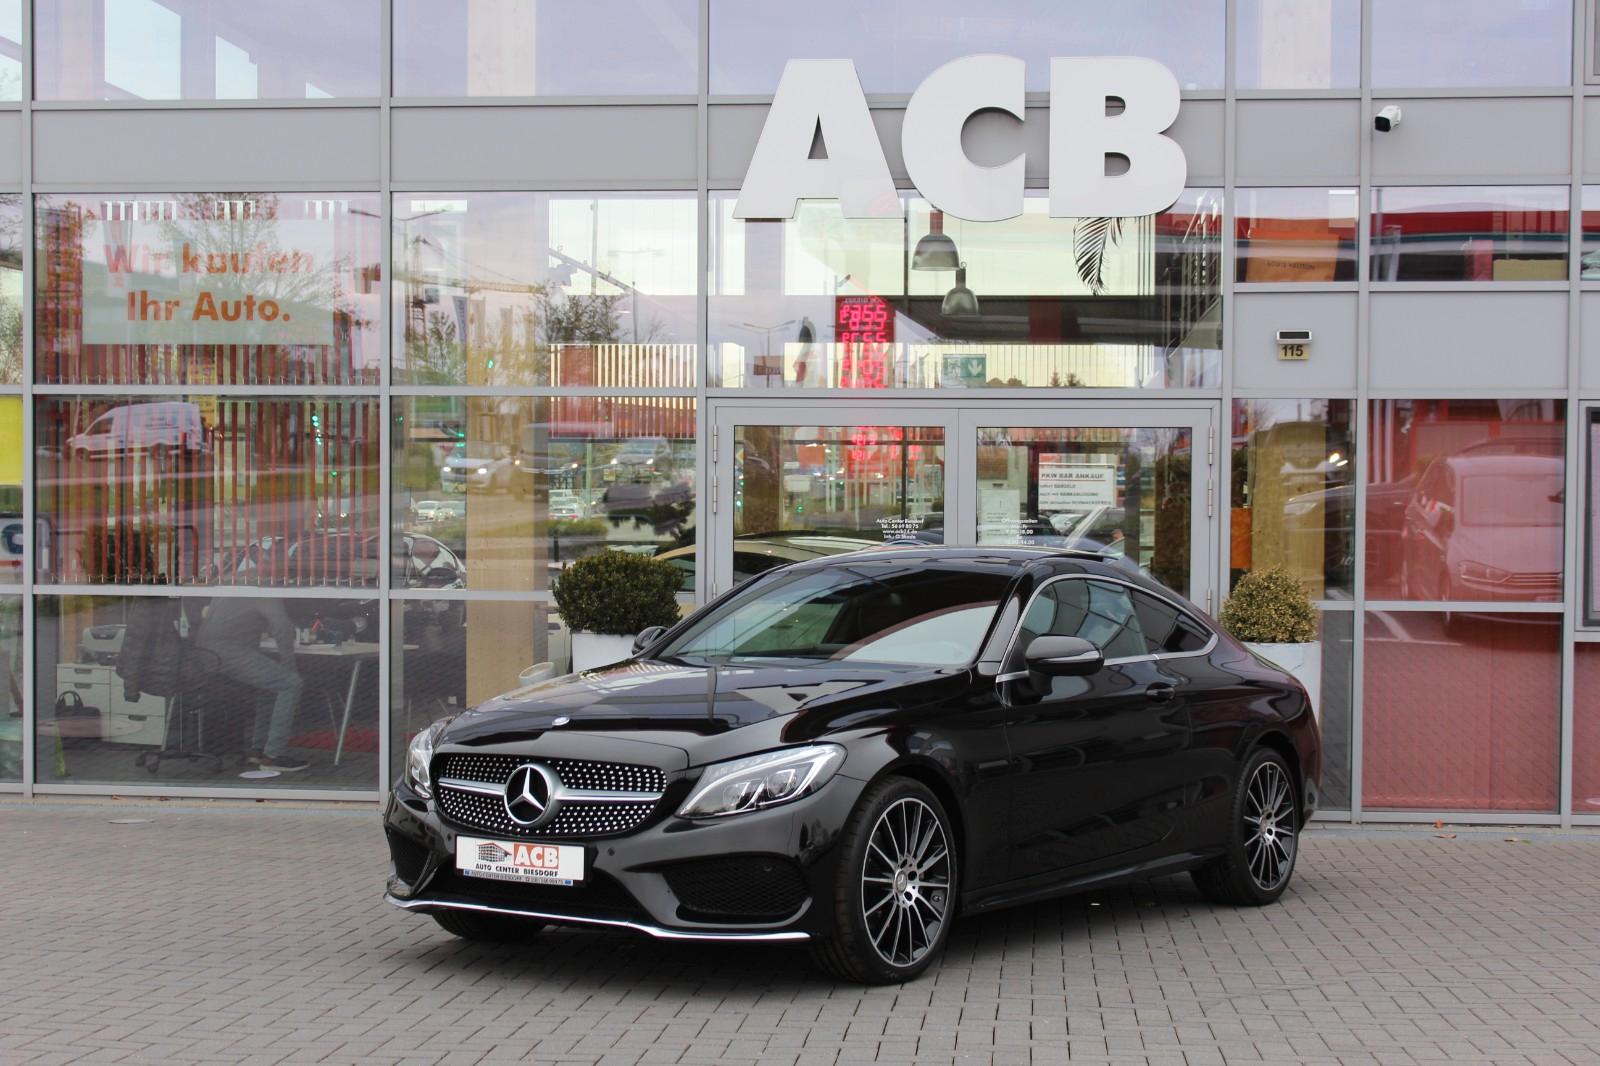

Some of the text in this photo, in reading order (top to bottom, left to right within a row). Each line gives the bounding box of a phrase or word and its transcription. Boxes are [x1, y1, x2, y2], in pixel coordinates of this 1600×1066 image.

[732, 53, 1187, 222] ACB
[104, 241, 314, 274] Wir kaufen
[127, 290, 291, 322] Ihr Auto.
[1281, 344, 1304, 357] 115
[475, 863, 559, 877] AUTO CENTER BIESDORF
[514, 845, 559, 868] ACB
